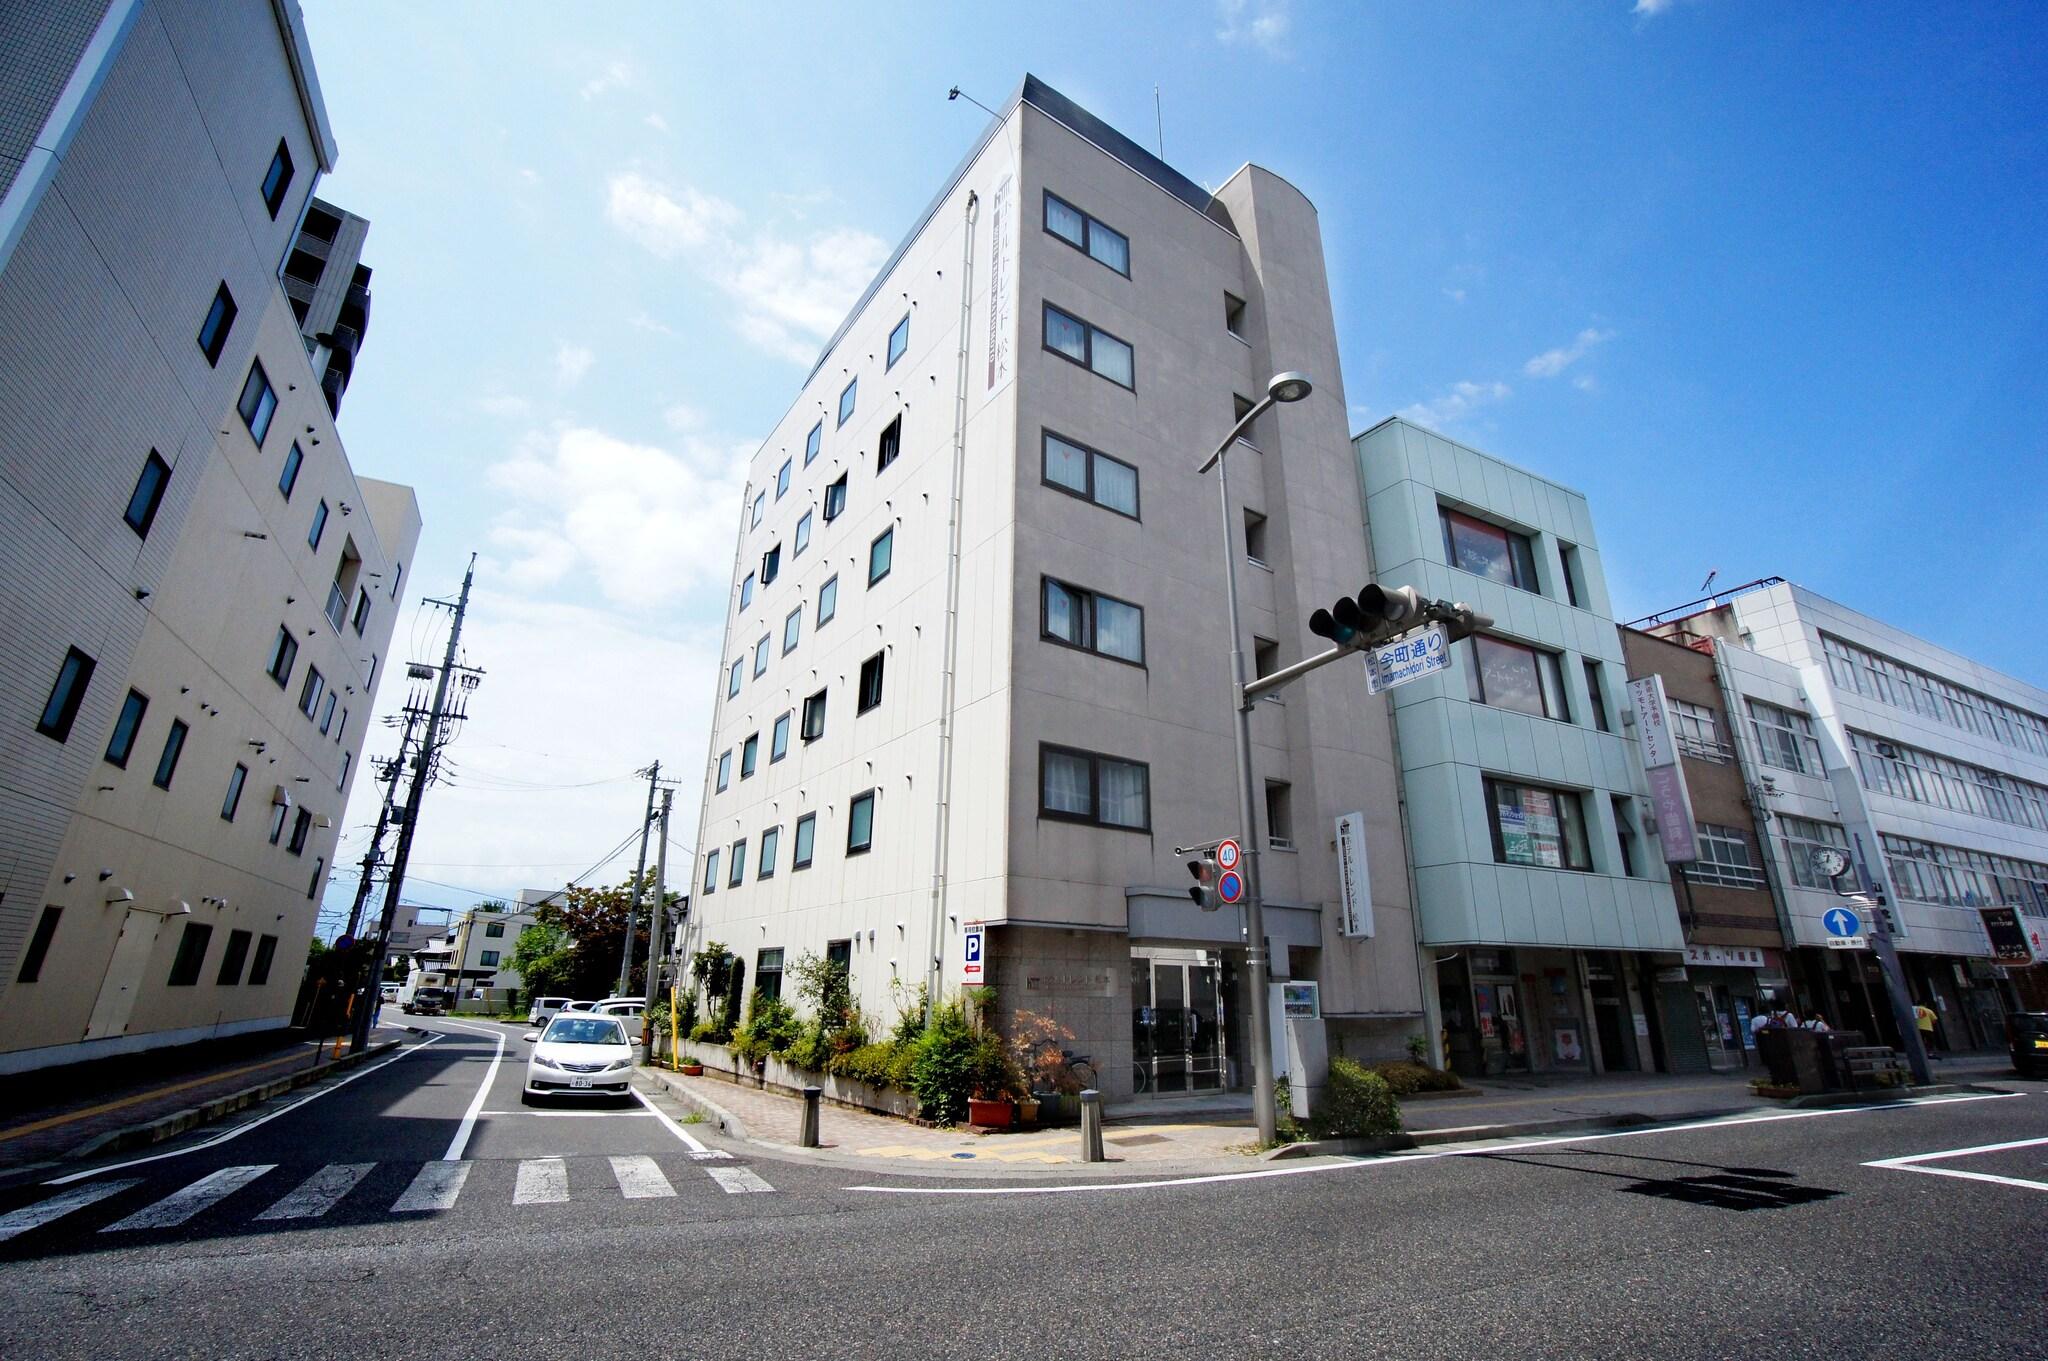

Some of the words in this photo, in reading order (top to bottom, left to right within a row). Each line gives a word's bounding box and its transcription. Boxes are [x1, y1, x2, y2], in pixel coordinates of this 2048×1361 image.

[1380, 632, 1442, 671] 今町通り
[1425, 652, 1447, 669] Street
[1223, 848, 1235, 862] 40
[967, 937, 979, 960] P
